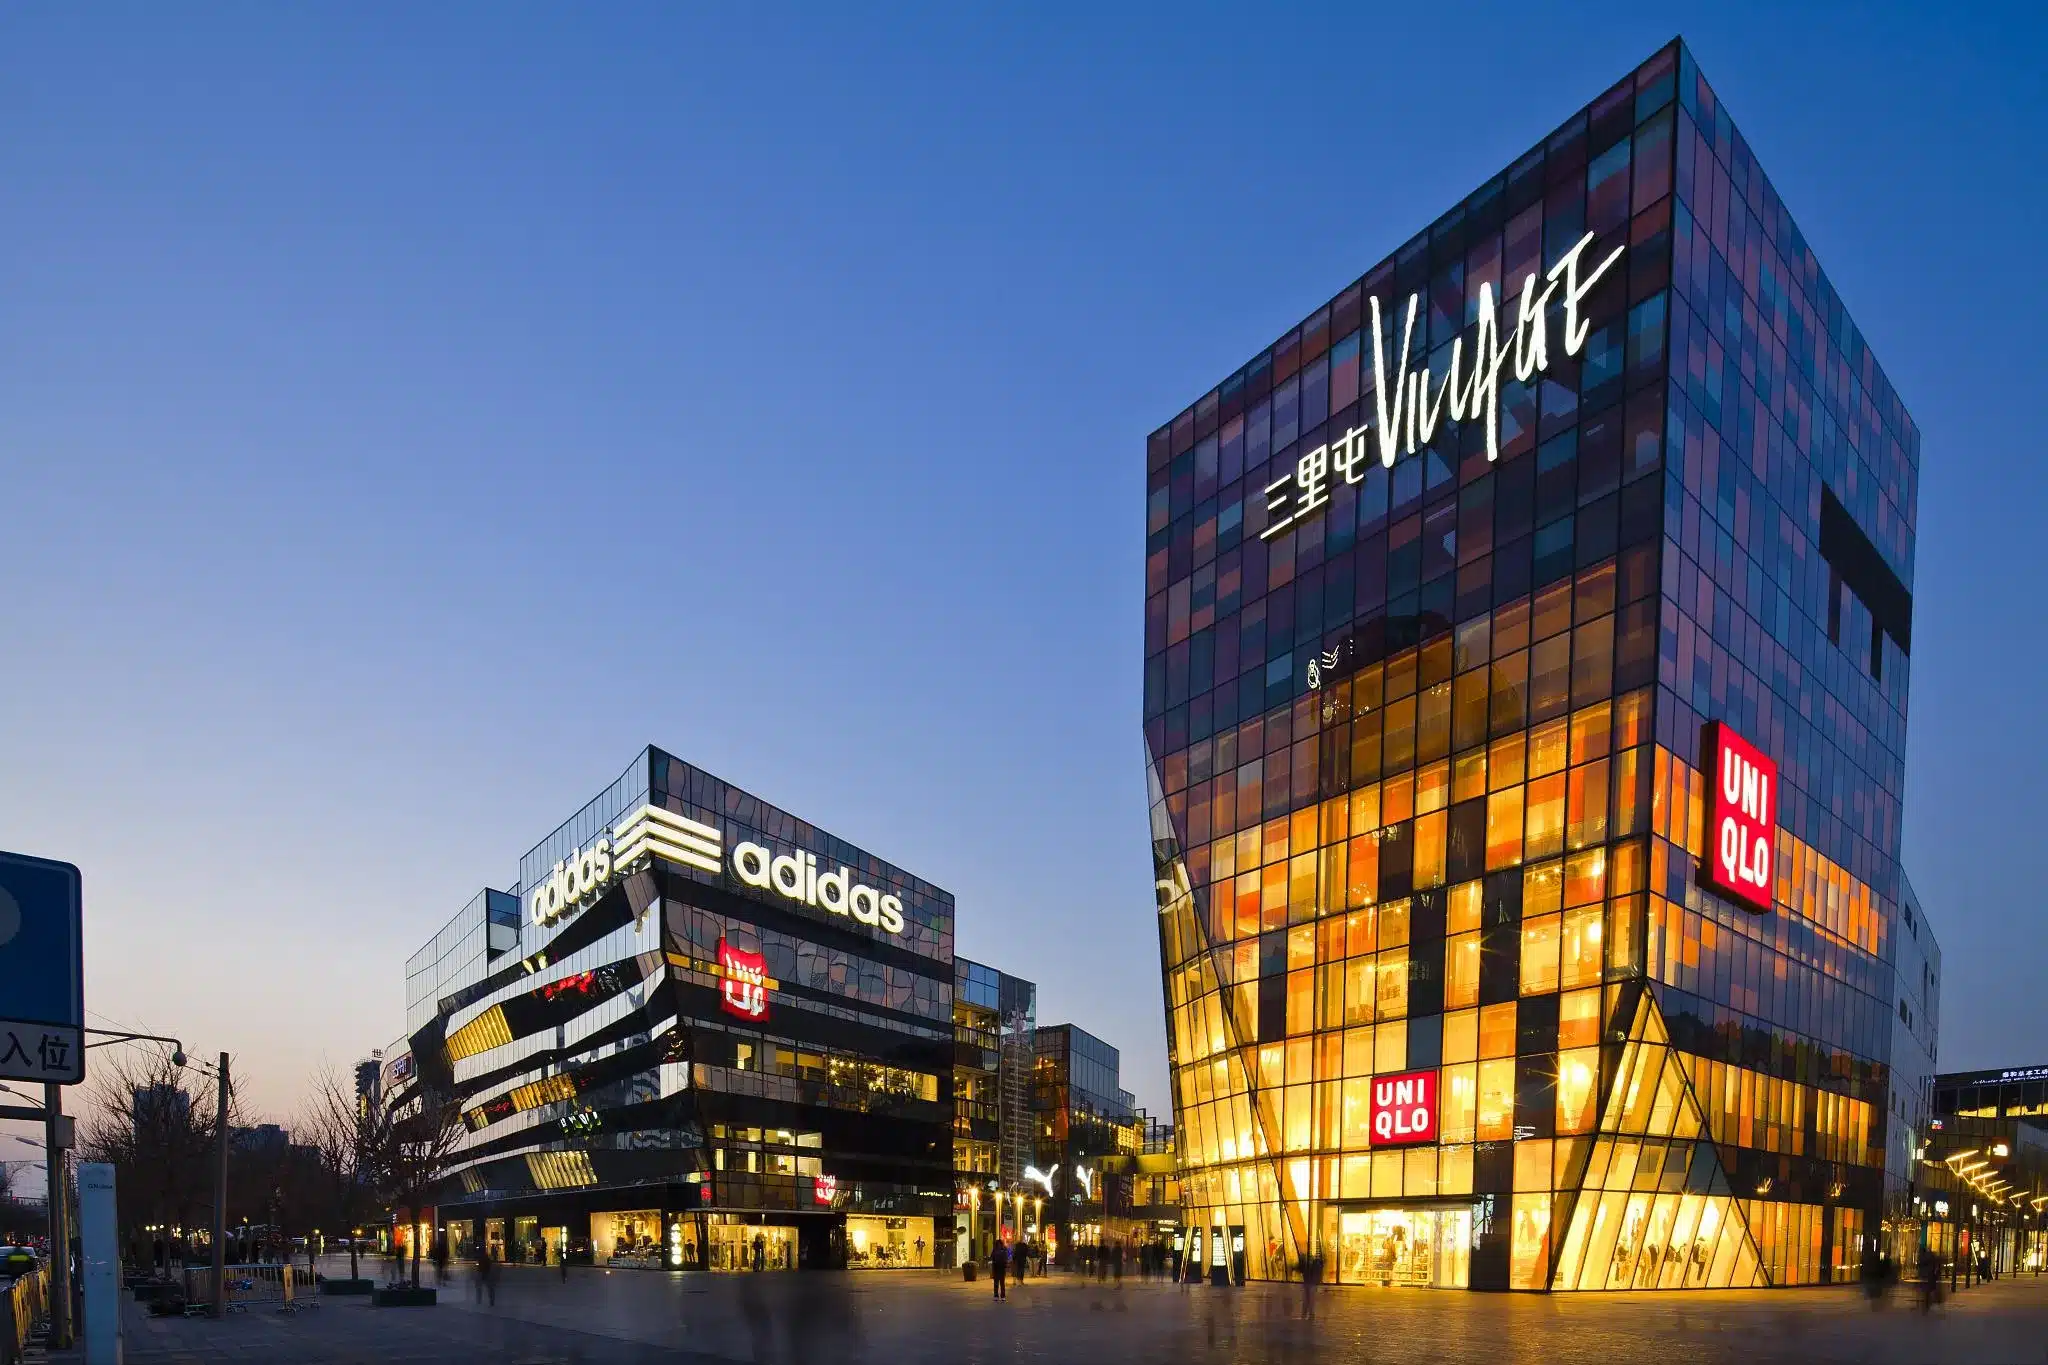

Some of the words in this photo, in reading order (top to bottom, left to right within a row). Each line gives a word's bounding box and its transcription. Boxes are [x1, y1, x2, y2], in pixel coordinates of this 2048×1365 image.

[1260, 424, 1368, 539] 三里屯
[1723, 746, 1768, 826] UNI
[531, 838, 612, 926] adidas
[733, 841, 905, 934] adidas
[1720, 816, 1769, 888] QLO
[0, 1031, 71, 1071] 入位
[1375, 1107, 1429, 1139] QLO
[1376, 1078, 1425, 1107] UNI
